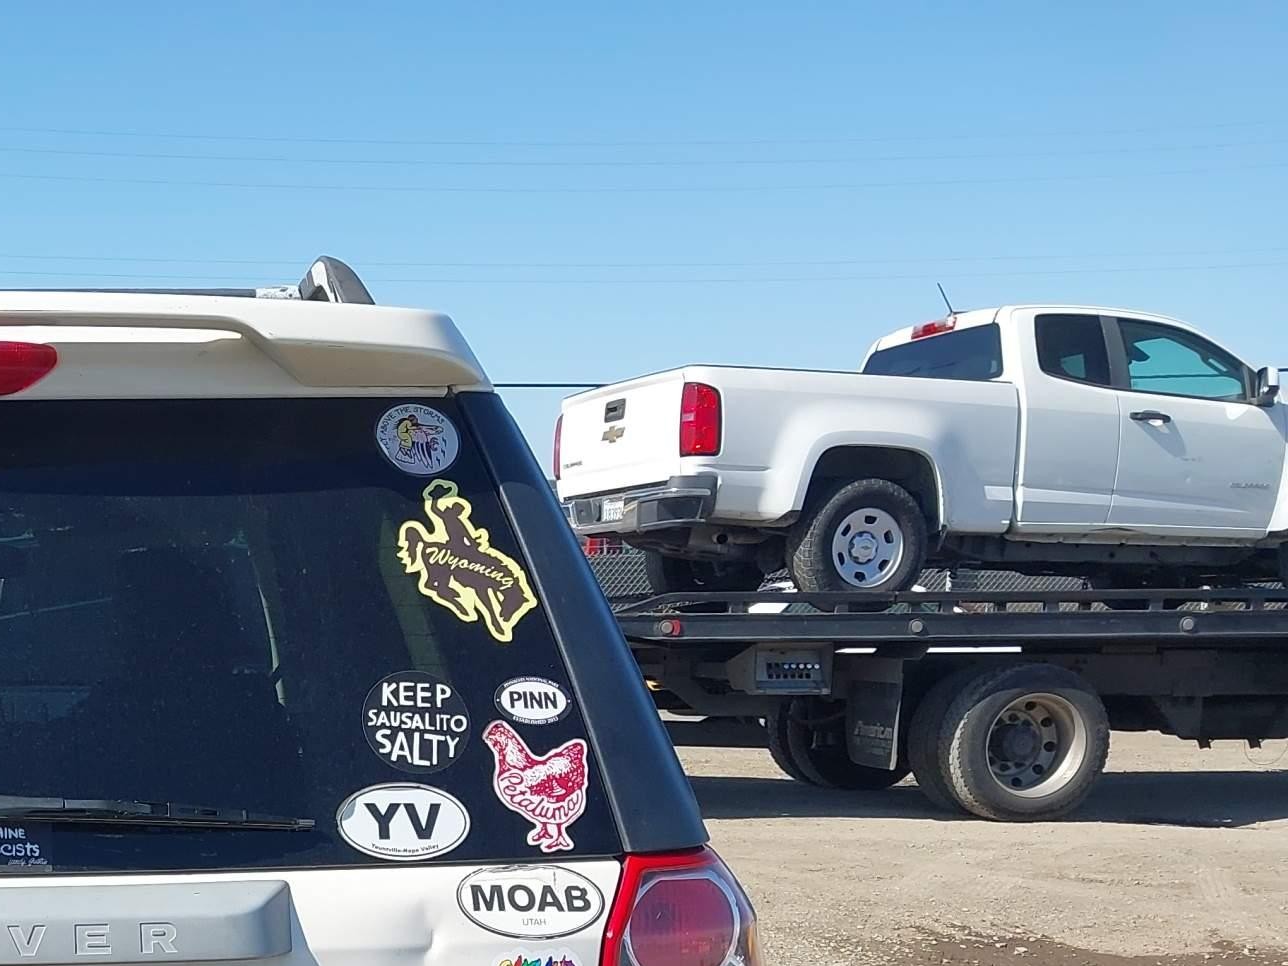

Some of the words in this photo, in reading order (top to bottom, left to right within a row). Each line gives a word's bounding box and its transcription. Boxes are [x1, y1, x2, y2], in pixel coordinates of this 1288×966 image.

[380, 414, 397, 434] ABOVE
[395, 406, 410, 415] THE
[413, 406, 446, 424] STORMS
[426, 547, 516, 589] Wyoming
[381, 682, 451, 708] KEEP
[509, 691, 558, 709] PINN
[367, 709, 467, 732] SAUSALITO
[375, 729, 460, 766] SALTY
[499, 770, 581, 822] Petaluma
[362, 802, 442, 841] YV
[470, 884, 592, 912] MOAB
[521, 917, 547, 927] UTAH
